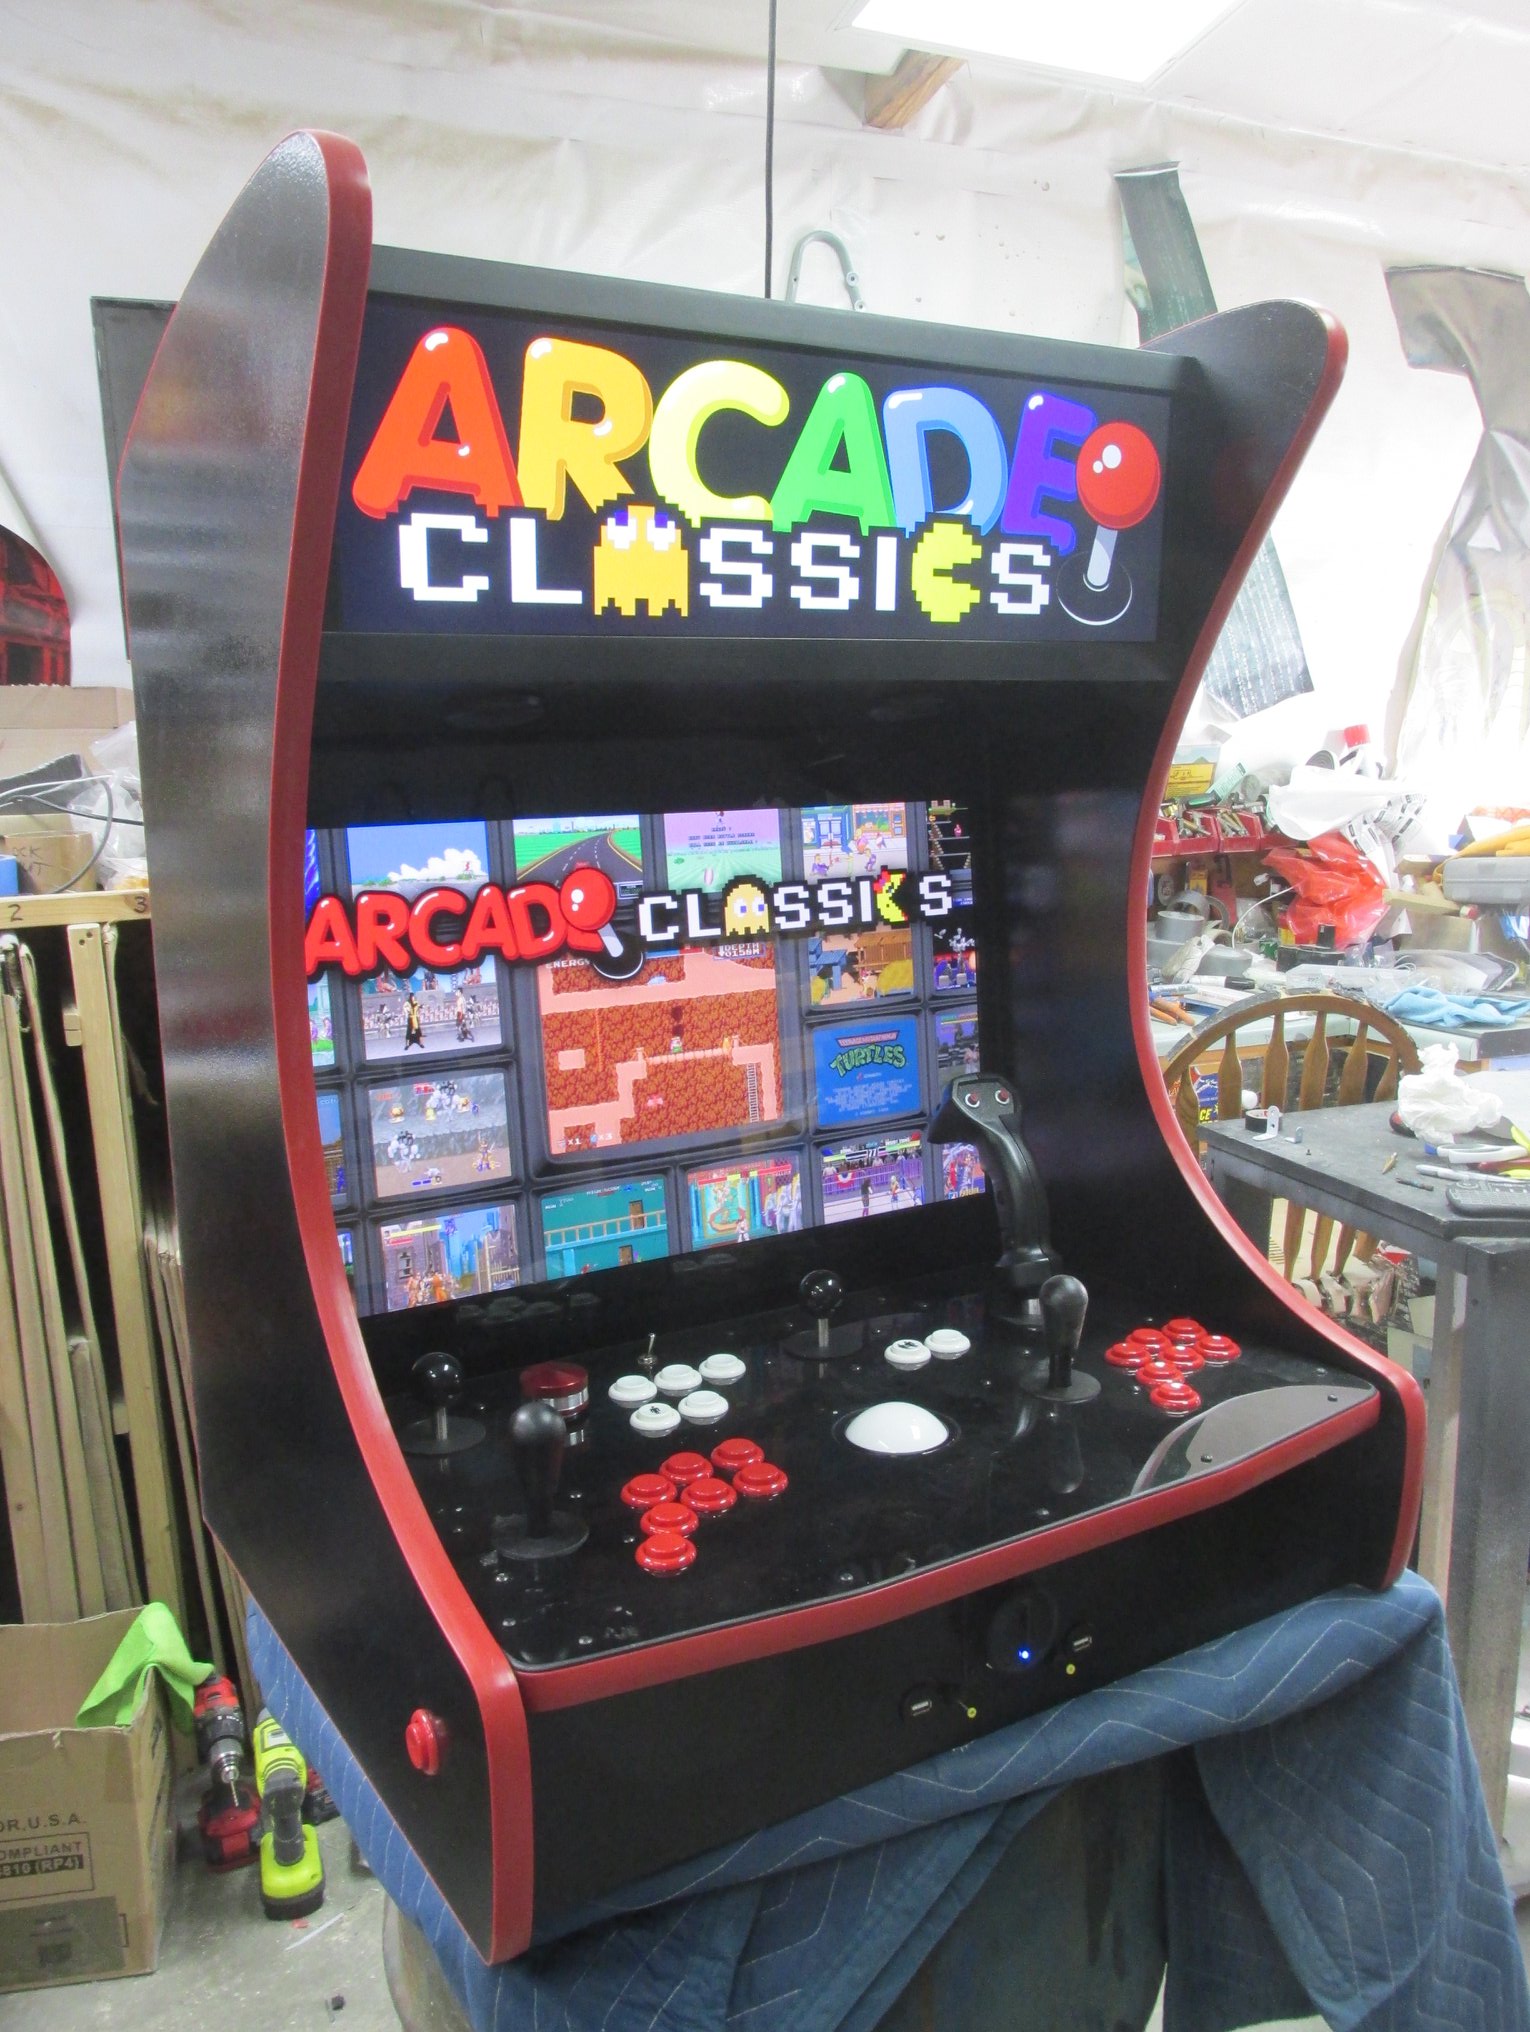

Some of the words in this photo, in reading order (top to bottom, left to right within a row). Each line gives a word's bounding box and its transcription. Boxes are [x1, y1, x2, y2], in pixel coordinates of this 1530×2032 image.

[352, 326, 1099, 556] ARCADE
[7, 903, 24, 922] 2
[133, 895, 148, 914] 3
[724, 942, 760, 952] DEPTH
[829, 1044, 906, 1077] TURTLES
